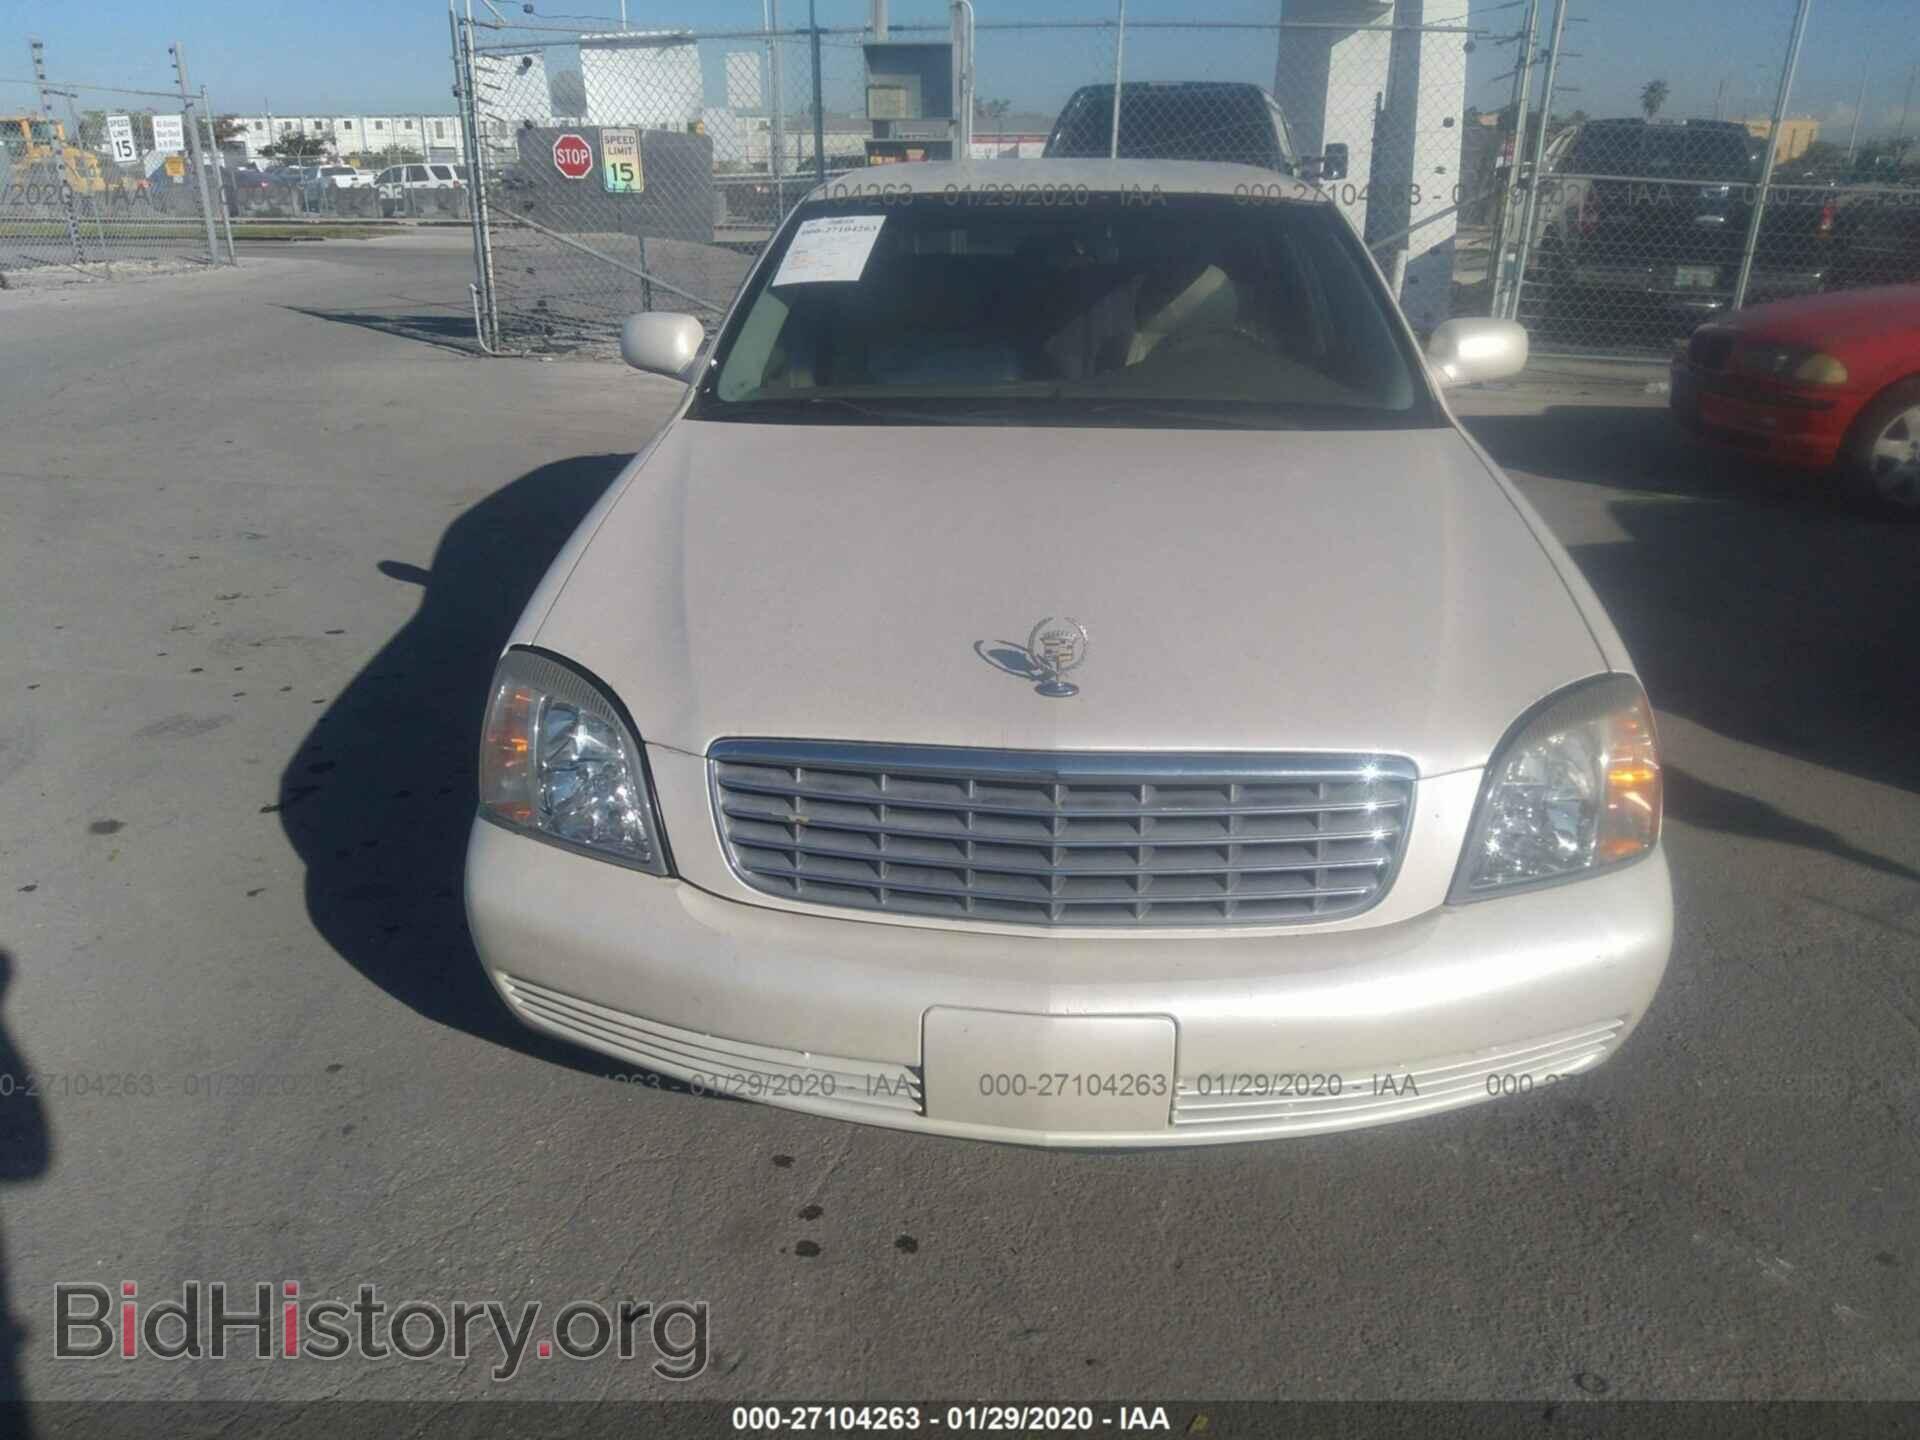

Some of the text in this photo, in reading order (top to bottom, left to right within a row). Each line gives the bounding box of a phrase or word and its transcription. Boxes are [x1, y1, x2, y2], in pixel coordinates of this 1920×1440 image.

[115, 140, 133, 158] 15
[604, 135, 635, 145] SPEED
[556, 148, 589, 166] STOP
[608, 146, 632, 156] LIMIT
[611, 162, 634, 182] 15
